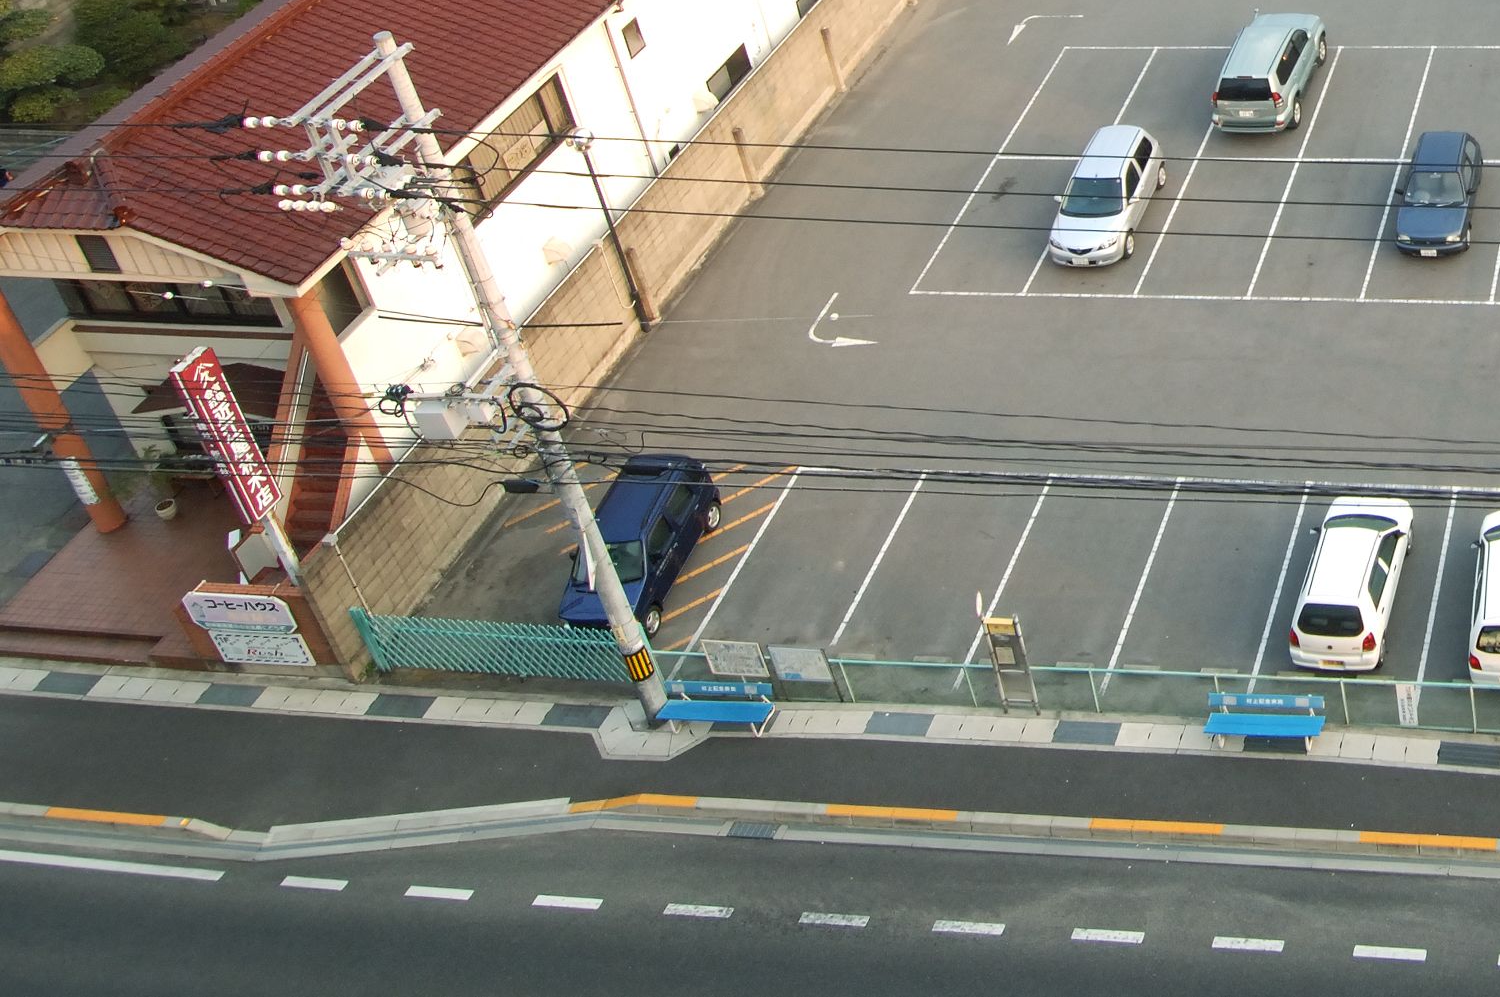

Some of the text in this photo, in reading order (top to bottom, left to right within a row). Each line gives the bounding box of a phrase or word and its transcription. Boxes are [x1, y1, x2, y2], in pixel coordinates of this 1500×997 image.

[204, 599, 280, 612] コーヒーハウス
